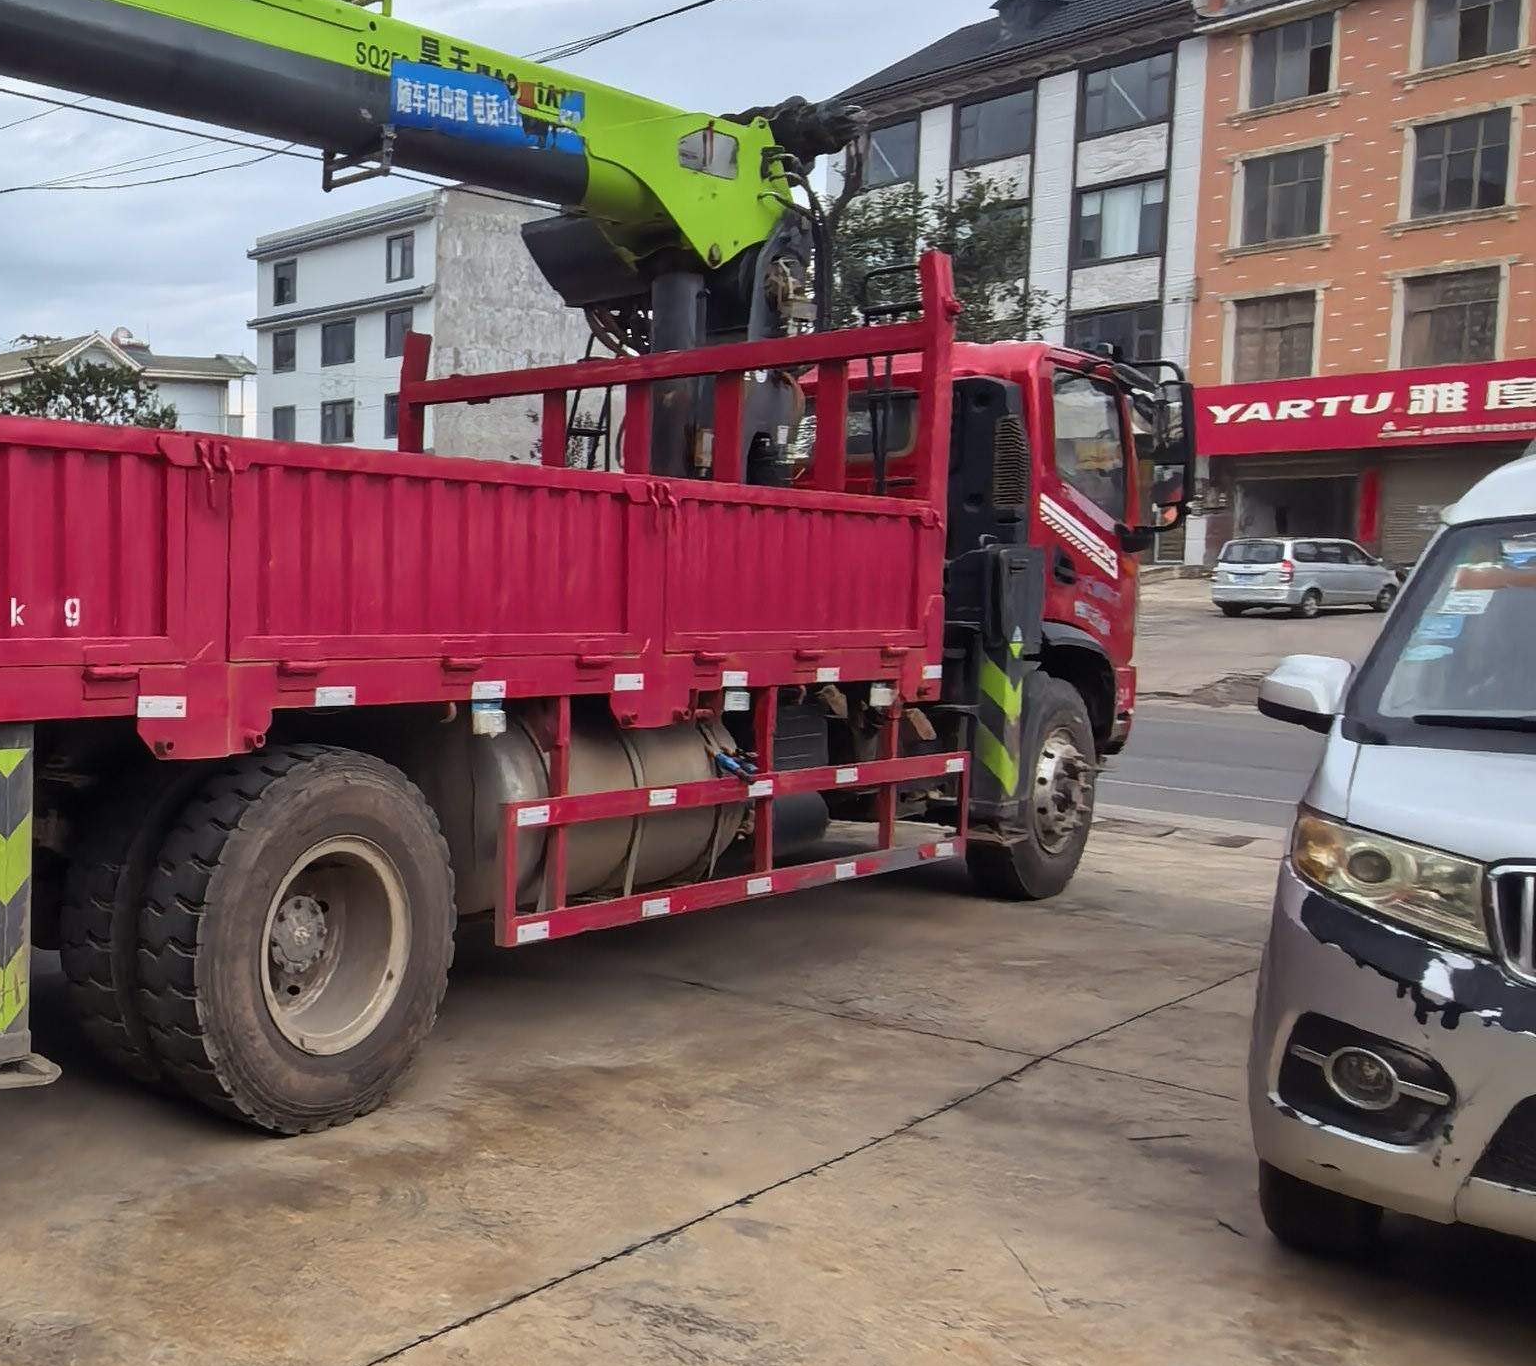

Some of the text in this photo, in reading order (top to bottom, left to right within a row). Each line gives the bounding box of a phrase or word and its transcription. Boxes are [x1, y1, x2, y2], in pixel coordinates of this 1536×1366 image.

[356, 41, 409, 72] SQ2
[1207, 376, 1536, 424] YARTU 雅度
